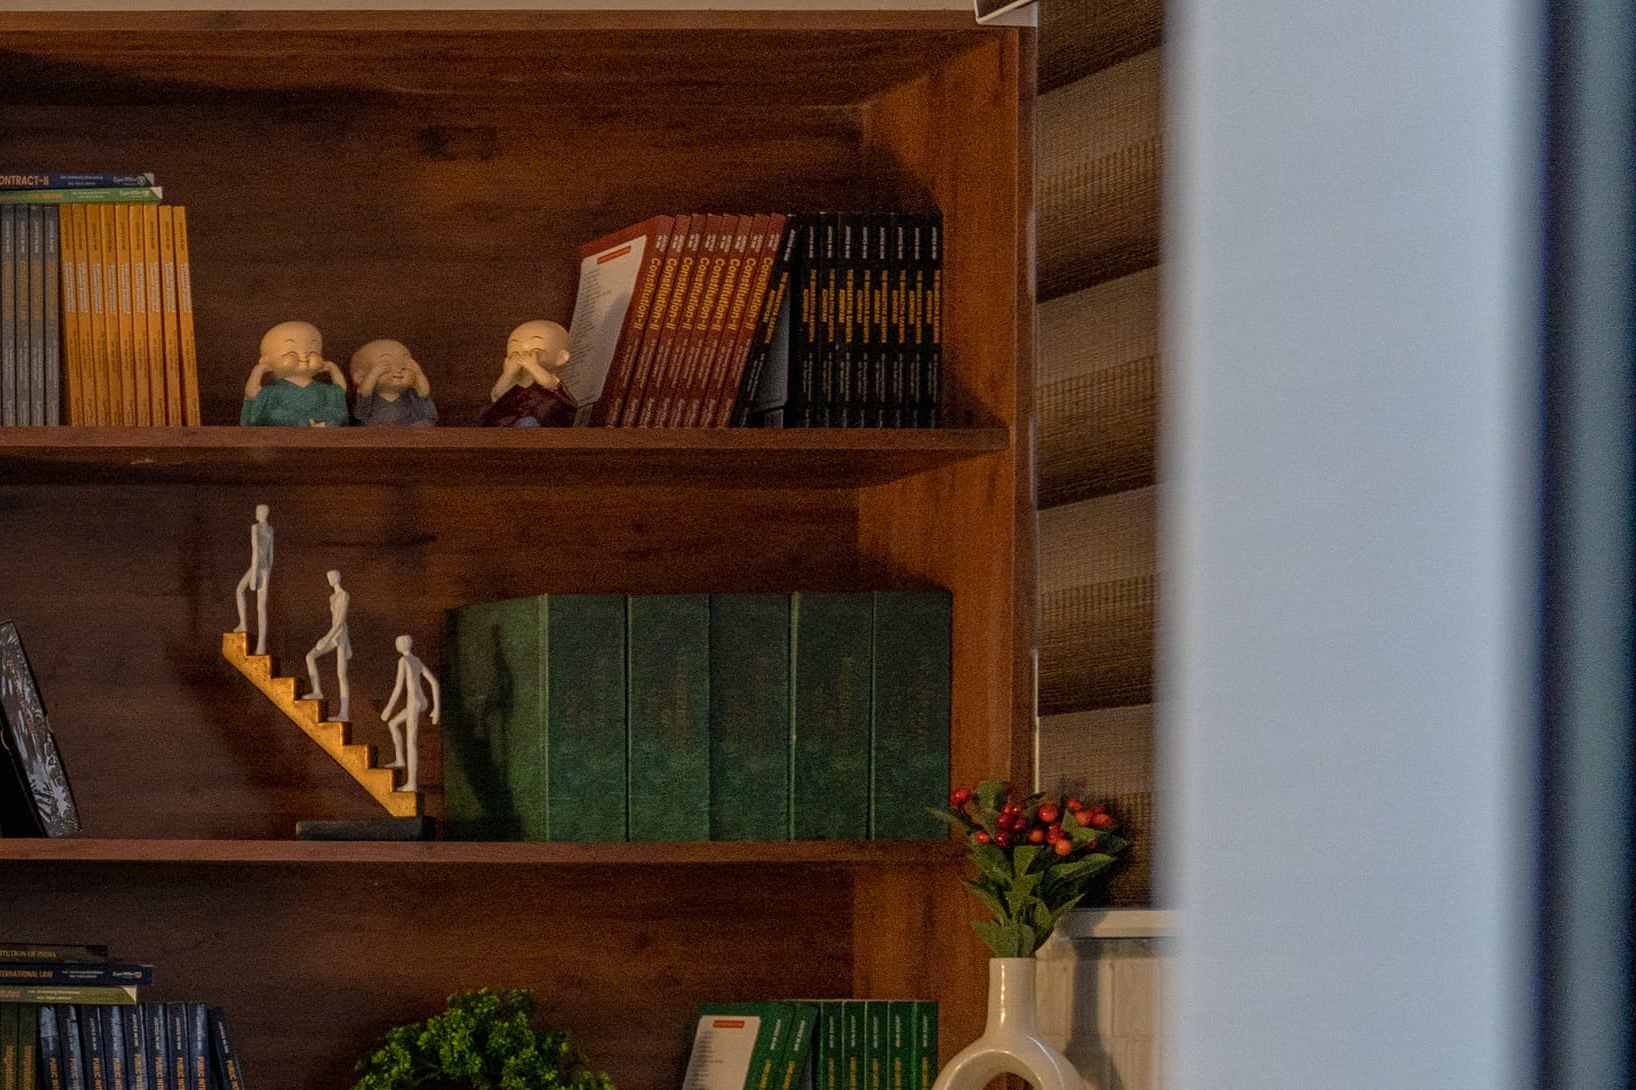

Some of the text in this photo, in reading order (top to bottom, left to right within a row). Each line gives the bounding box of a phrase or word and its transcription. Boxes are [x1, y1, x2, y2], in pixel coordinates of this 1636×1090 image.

[633, 257, 660, 329] Constitution-II
[650, 258, 677, 330] Constitution-II
[666, 257, 692, 330] Constitution-II
[682, 257, 709, 330] Constitution-II
[697, 258, 724, 330] Constitution-II
[712, 259, 740, 331] Constitution-II
[728, 258, 756, 330] Constitution-II
[746, 257, 773, 330] Constitution-II
